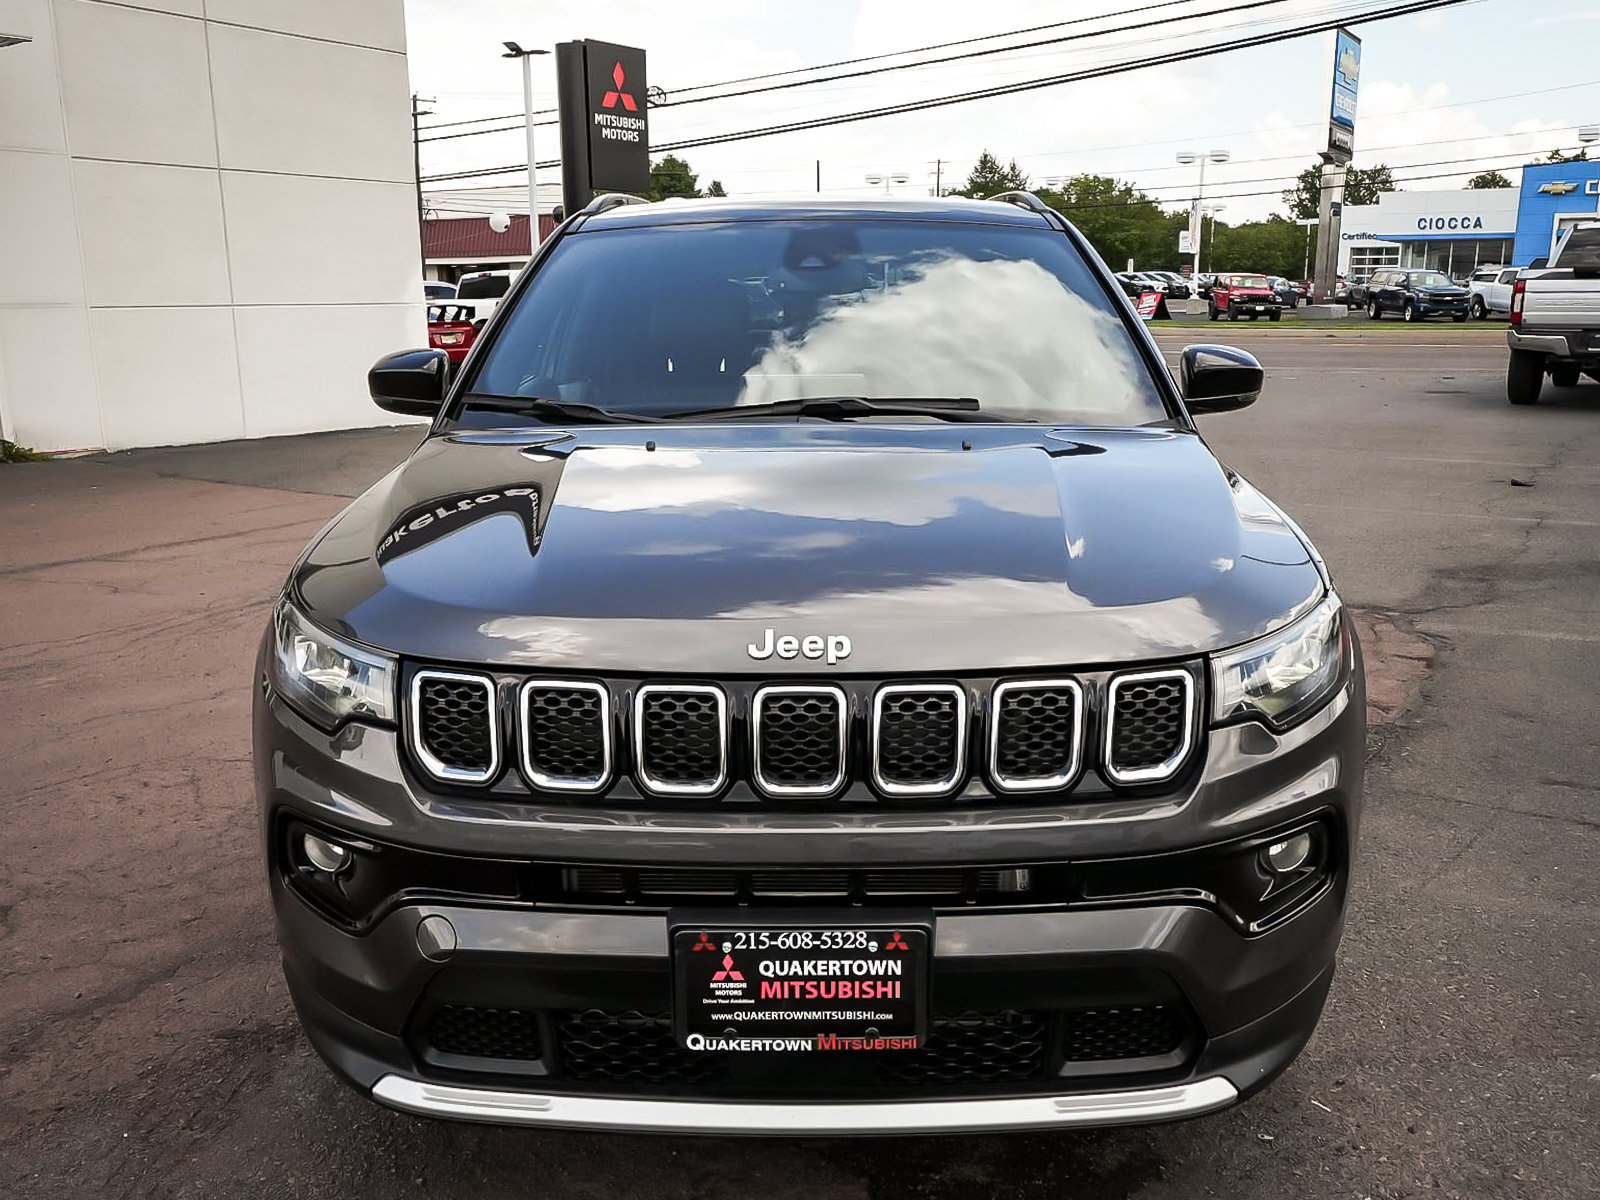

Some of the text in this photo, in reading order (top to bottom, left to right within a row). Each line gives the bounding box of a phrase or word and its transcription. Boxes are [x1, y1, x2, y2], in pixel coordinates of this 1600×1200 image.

[595, 113, 645, 130] MITSUBISHI
[602, 127, 640, 142] MOTORS
[1417, 216, 1484, 231] CIOCCA
[747, 629, 853, 665] Jeep
[733, 930, 868, 951] 215-608-5328
[758, 960, 902, 978] QUAKERTOWN
[760, 980, 902, 999] MITSUBISHI
[686, 1033, 918, 1052] QUAKERTOWN MITSUBISHI
